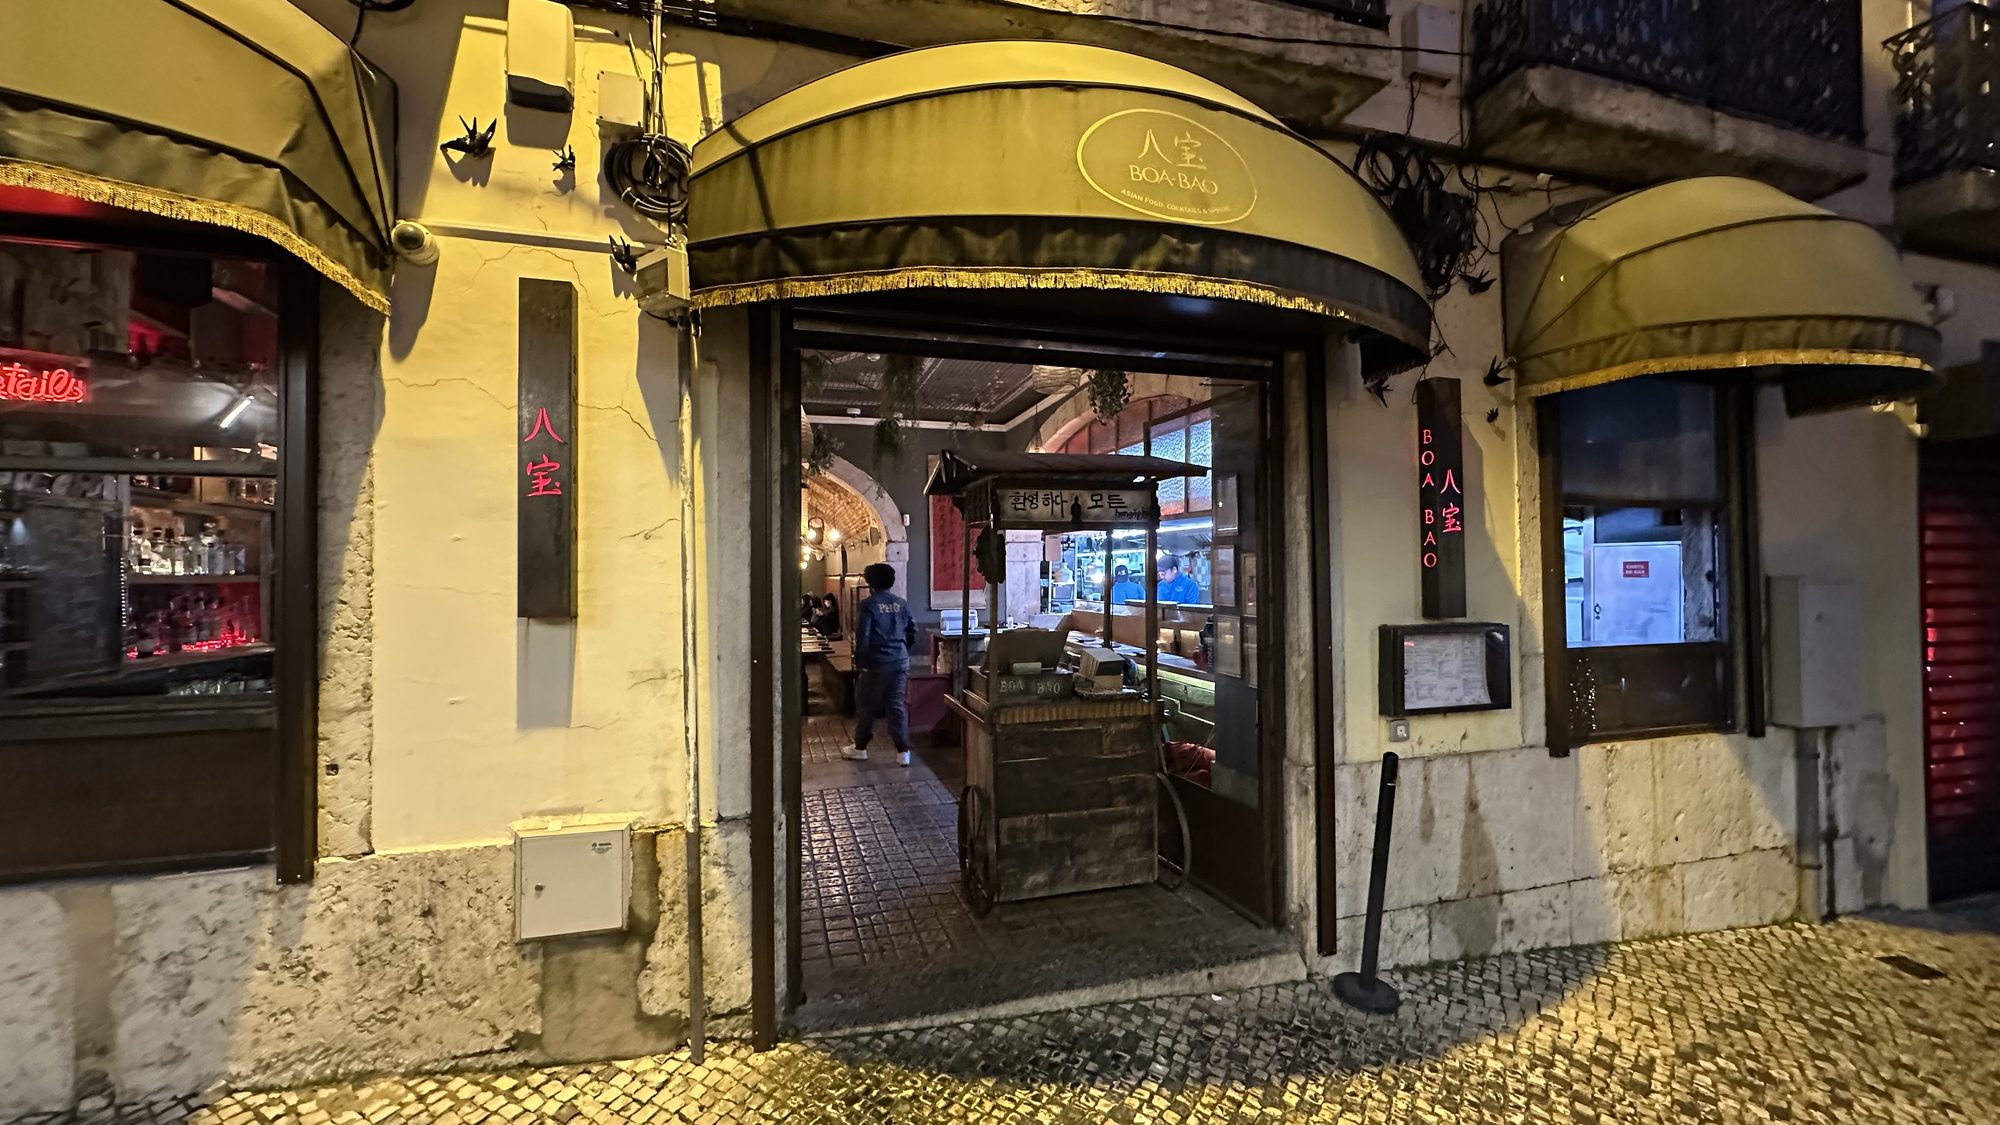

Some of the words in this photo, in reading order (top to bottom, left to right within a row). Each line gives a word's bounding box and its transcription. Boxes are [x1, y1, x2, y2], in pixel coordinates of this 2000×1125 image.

[1138, 128, 1207, 170] 八宝
[1121, 189, 1144, 202] ASIAN
[1145, 197, 1164, 208] FOOD
[0, 362, 84, 403] tails
[524, 407, 566, 497] 八宝
[1421, 429, 1435, 488] BOA
[1087, 493, 1128, 509] 모든
[1440, 468, 1463, 534] 八宝
[1423, 508, 1437, 568] BAO
[1000, 679, 1024, 694] BOA
[1036, 681, 1061, 695] BAO
